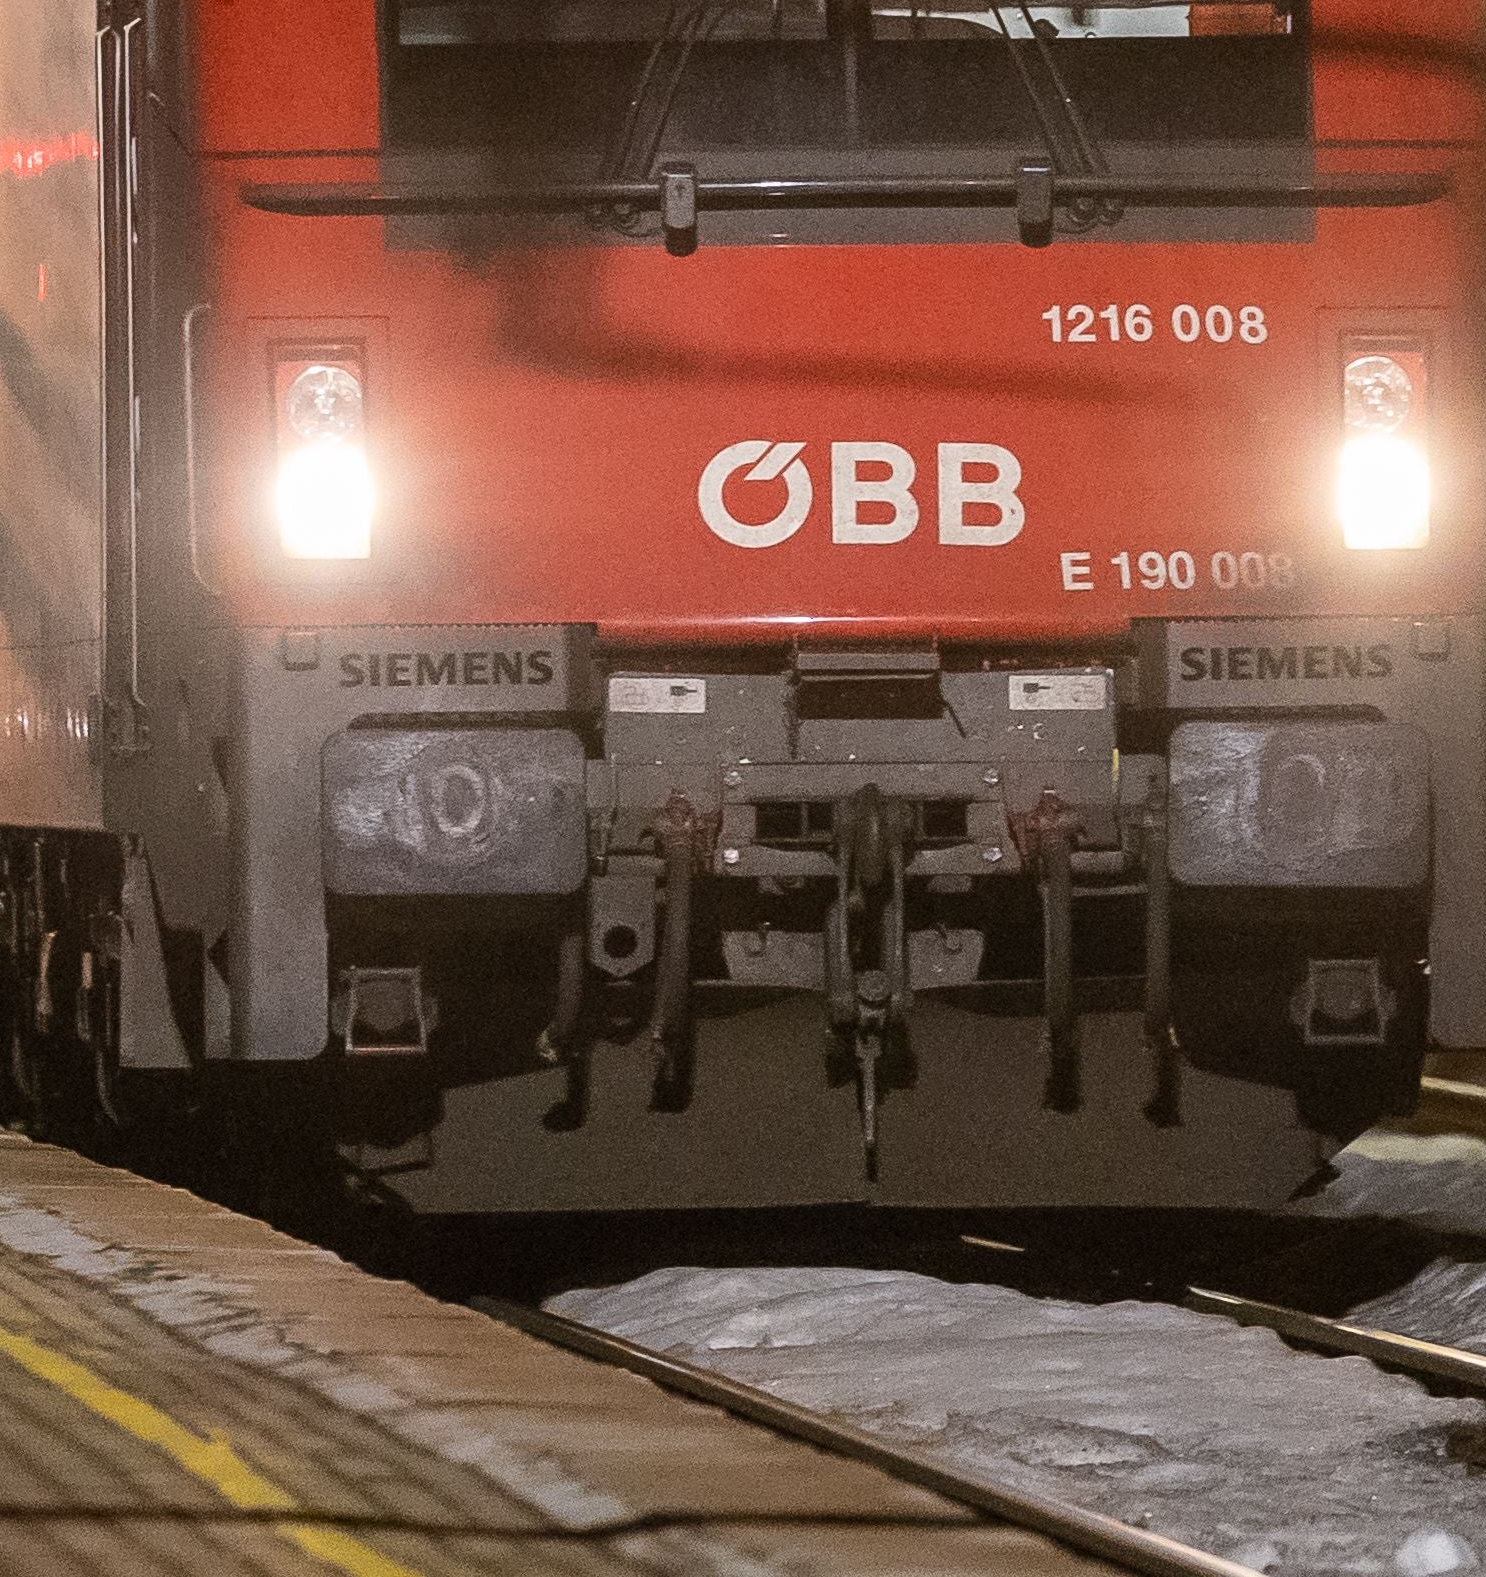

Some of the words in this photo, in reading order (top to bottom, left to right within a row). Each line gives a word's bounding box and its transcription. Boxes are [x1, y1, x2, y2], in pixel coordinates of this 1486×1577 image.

[1041, 304, 1154, 343] 1216
[1171, 304, 1269, 345] 008
[697, 439, 1027, 549] ÖBB
[1060, 552, 1095, 591] E
[1110, 551, 1196, 590] 190
[1210, 550, 1295, 590] 008
[339, 650, 555, 688] SIEMENS
[1179, 642, 1396, 682] SIEMENS
